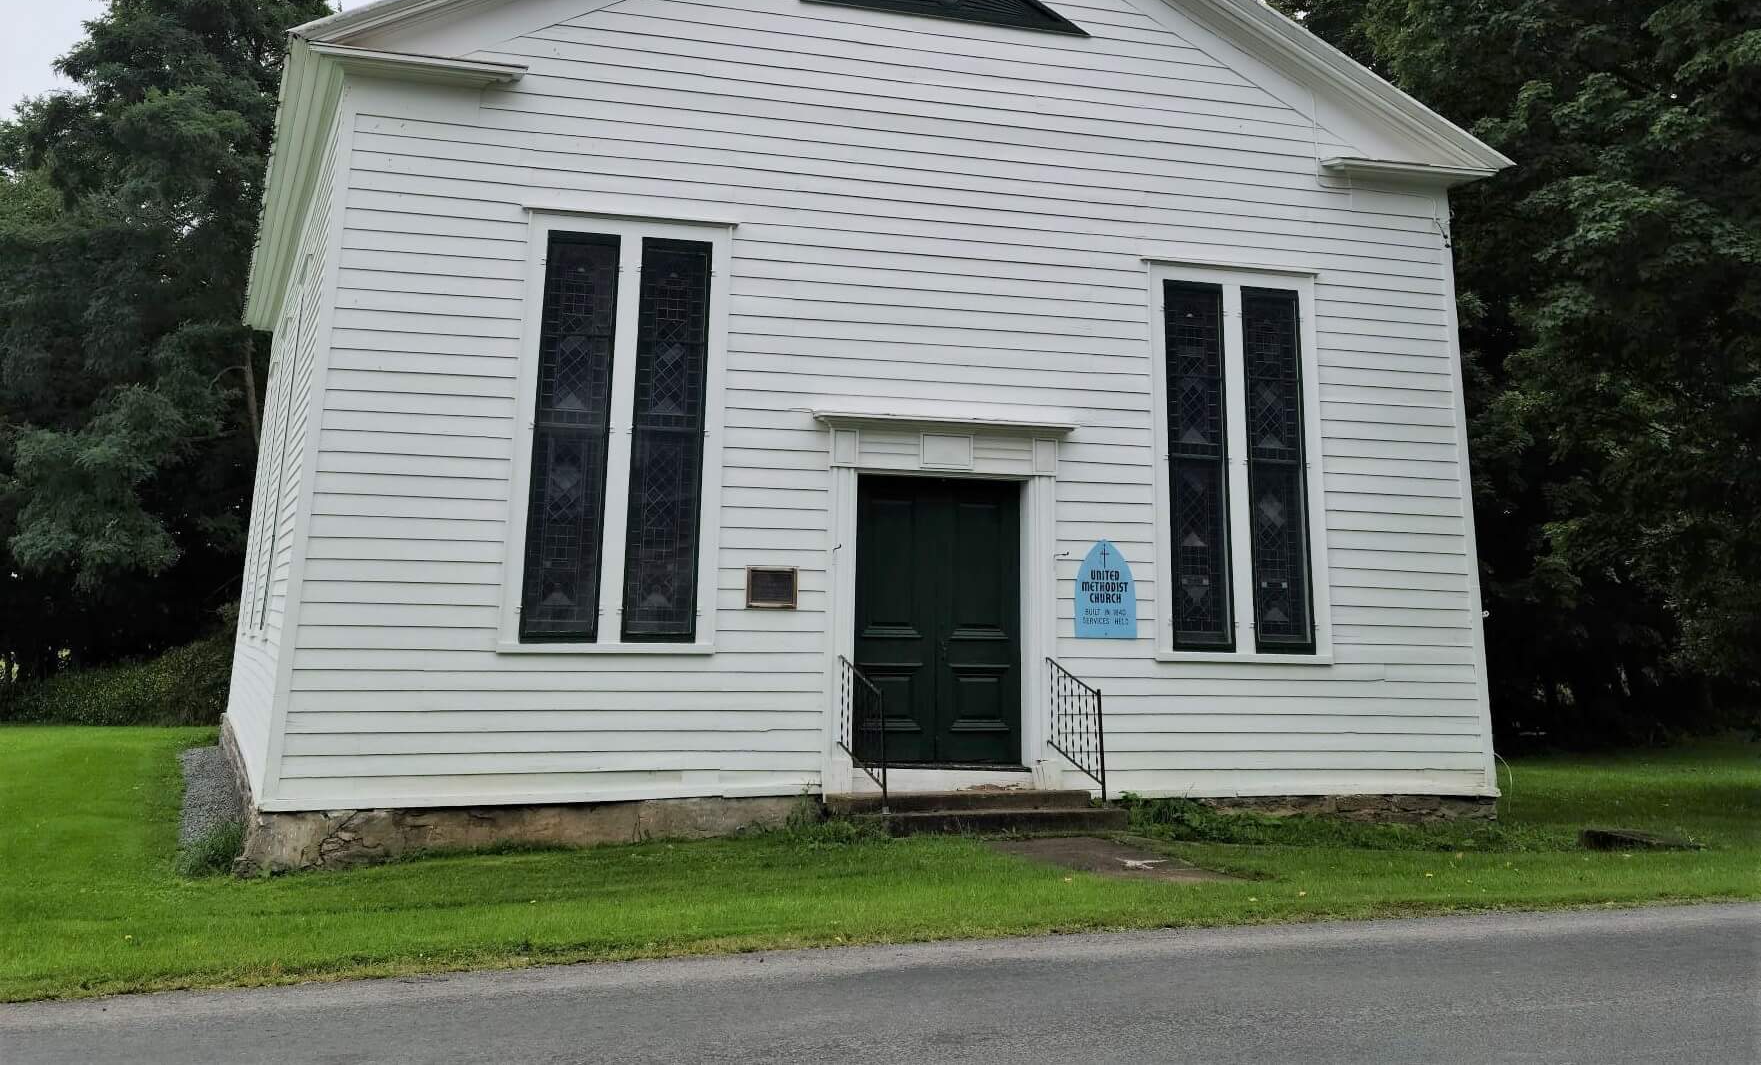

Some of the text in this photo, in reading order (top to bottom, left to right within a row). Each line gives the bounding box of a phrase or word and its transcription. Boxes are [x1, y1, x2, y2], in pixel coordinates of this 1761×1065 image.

[1090, 570, 1120, 581] UNITED
[1082, 582, 1128, 592] METHODIST
[1090, 593, 1121, 604] CHURCH
